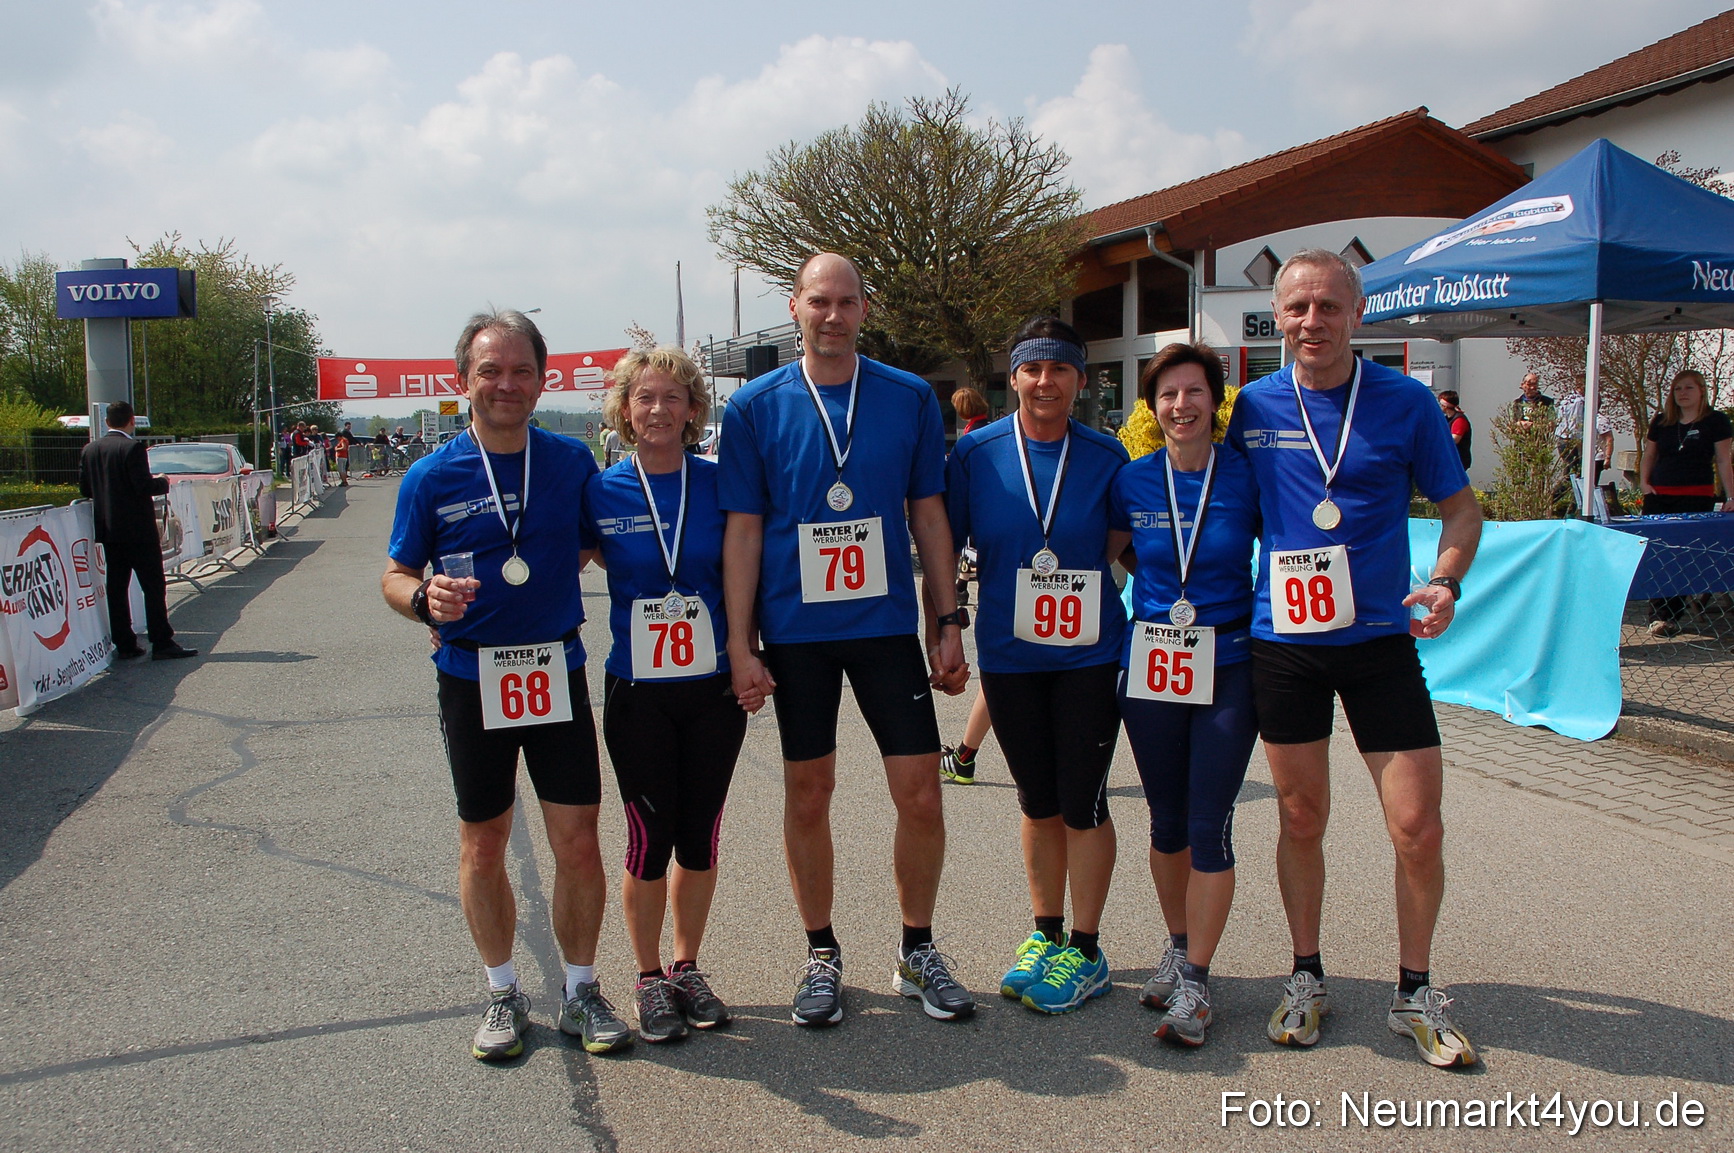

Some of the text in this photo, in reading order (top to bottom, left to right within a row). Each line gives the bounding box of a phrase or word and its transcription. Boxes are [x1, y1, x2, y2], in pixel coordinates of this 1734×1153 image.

[67, 282, 161, 302] VOLVO
[1432, 272, 1510, 307] Tagblatt
[812, 525, 852, 537] MEYER
[812, 535, 853, 544] WERBUNG
[1278, 554, 1312, 566] MEYER
[819, 544, 866, 592] 79
[1279, 564, 1313, 573] WERBUNG
[1030, 573, 1069, 583] MEYER
[1030, 582, 1069, 590] WERBUNG
[1285, 575, 1336, 625] 98
[1034, 594, 1082, 640] 99
[1144, 625, 1182, 639] MEYER
[648, 620, 695, 669] 78
[1144, 635, 1182, 646] WERBUNG
[493, 648, 535, 661] MEYER
[494, 658, 535, 668] WERBUNG
[1146, 648, 1194, 696] 65
[500, 670, 552, 720] 68
